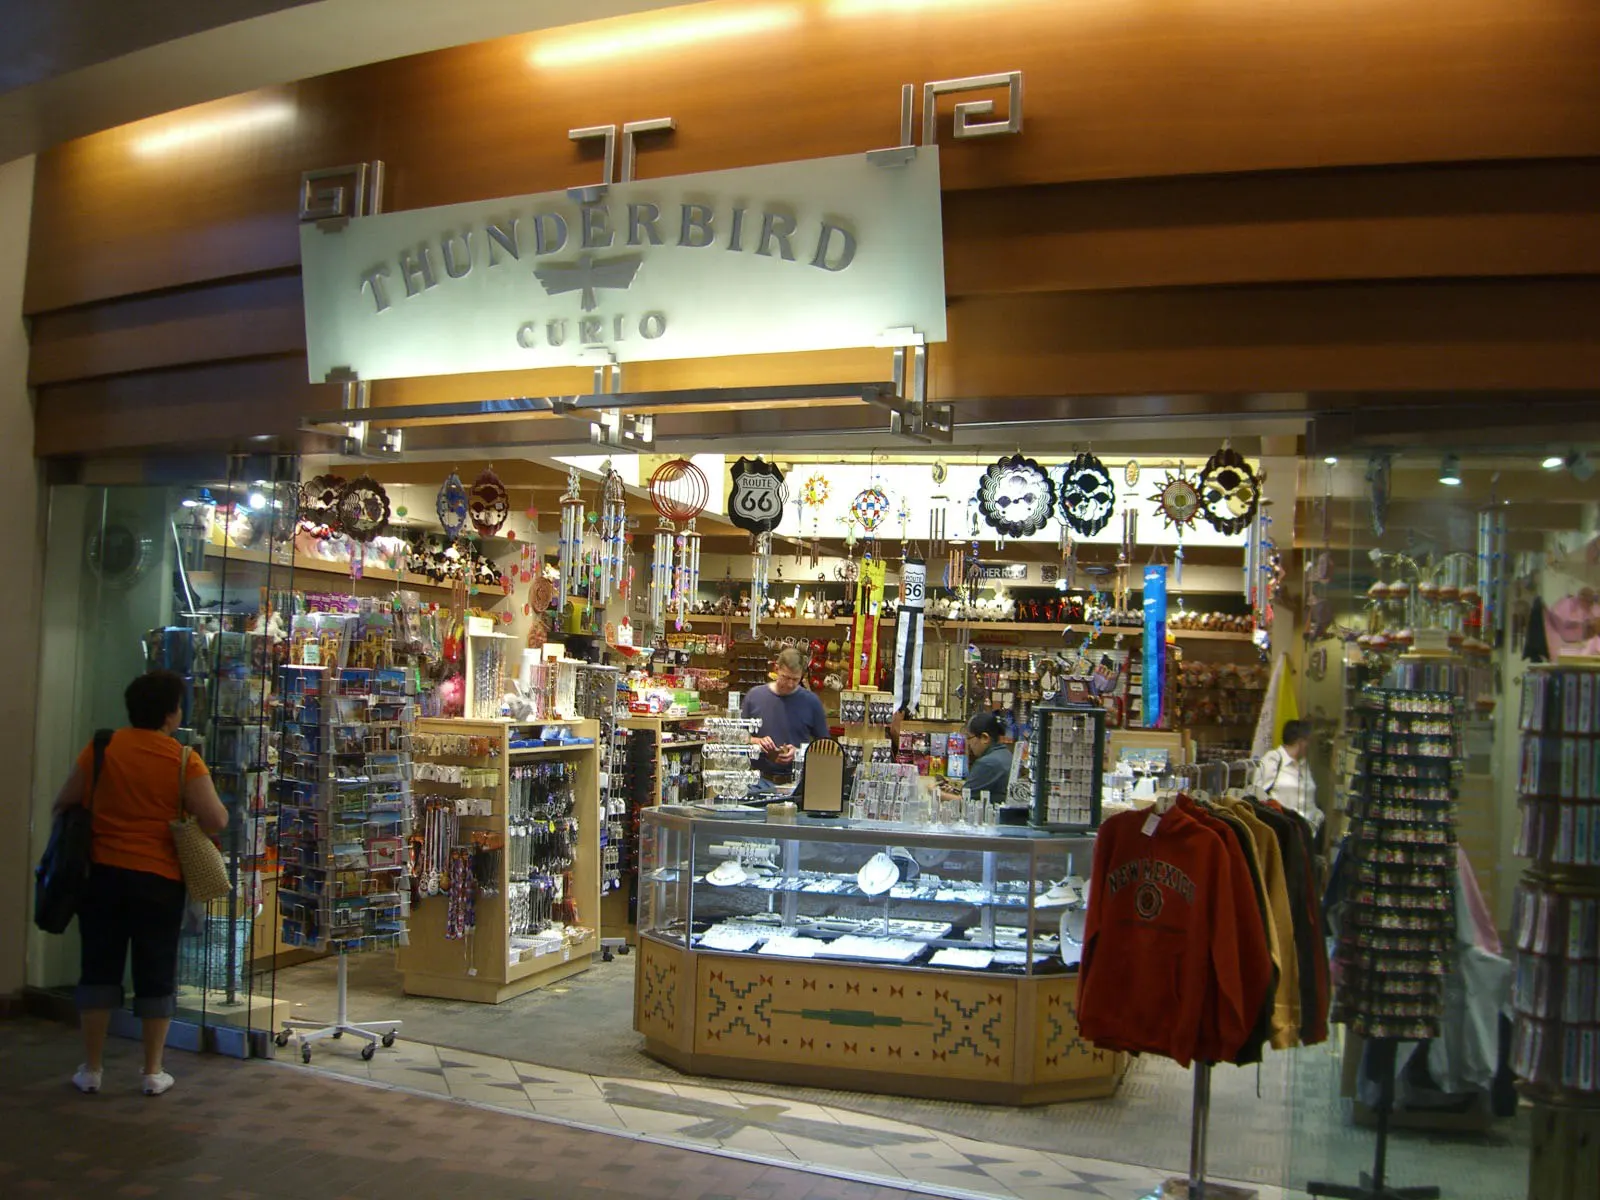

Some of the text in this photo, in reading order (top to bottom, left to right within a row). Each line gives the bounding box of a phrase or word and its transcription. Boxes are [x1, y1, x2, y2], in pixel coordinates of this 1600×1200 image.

[360, 202, 858, 314] THUNDERBIRD
[516, 312, 667, 349] CURIO
[742, 478, 772, 487] ROUTE
[741, 490, 772, 512] 66
[905, 583, 922, 597] 66
[1108, 858, 1196, 906] NEW MEXICO
